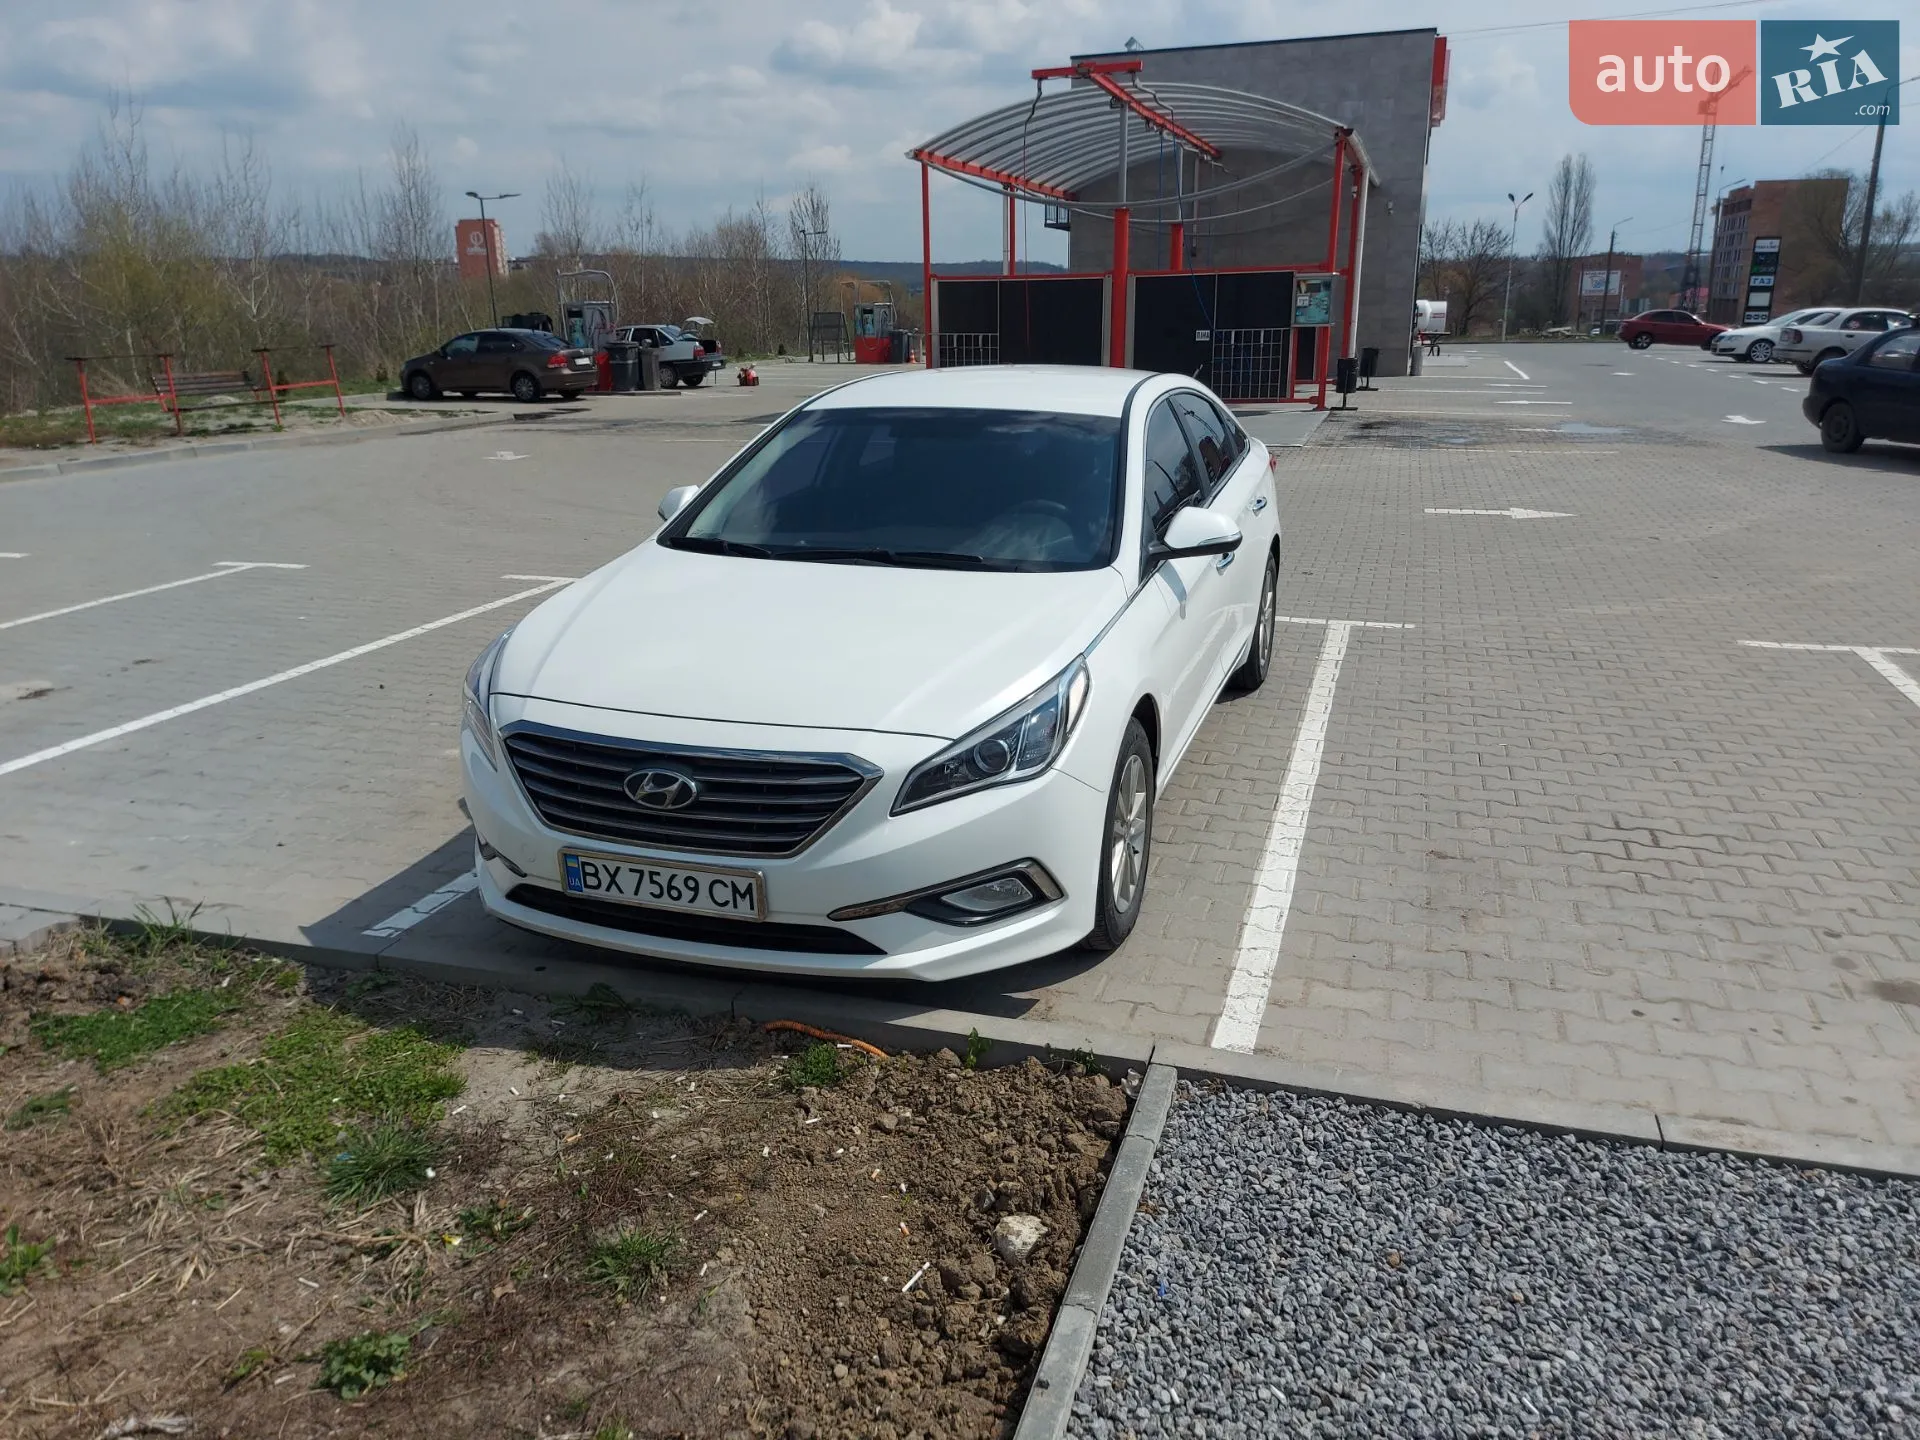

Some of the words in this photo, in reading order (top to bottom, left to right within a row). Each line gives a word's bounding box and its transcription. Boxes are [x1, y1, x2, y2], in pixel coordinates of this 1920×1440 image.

[568, 877, 581, 887] UA
[580, 861, 625, 895] BX
[628, 867, 700, 904] 7569
[708, 879, 755, 911] CM
